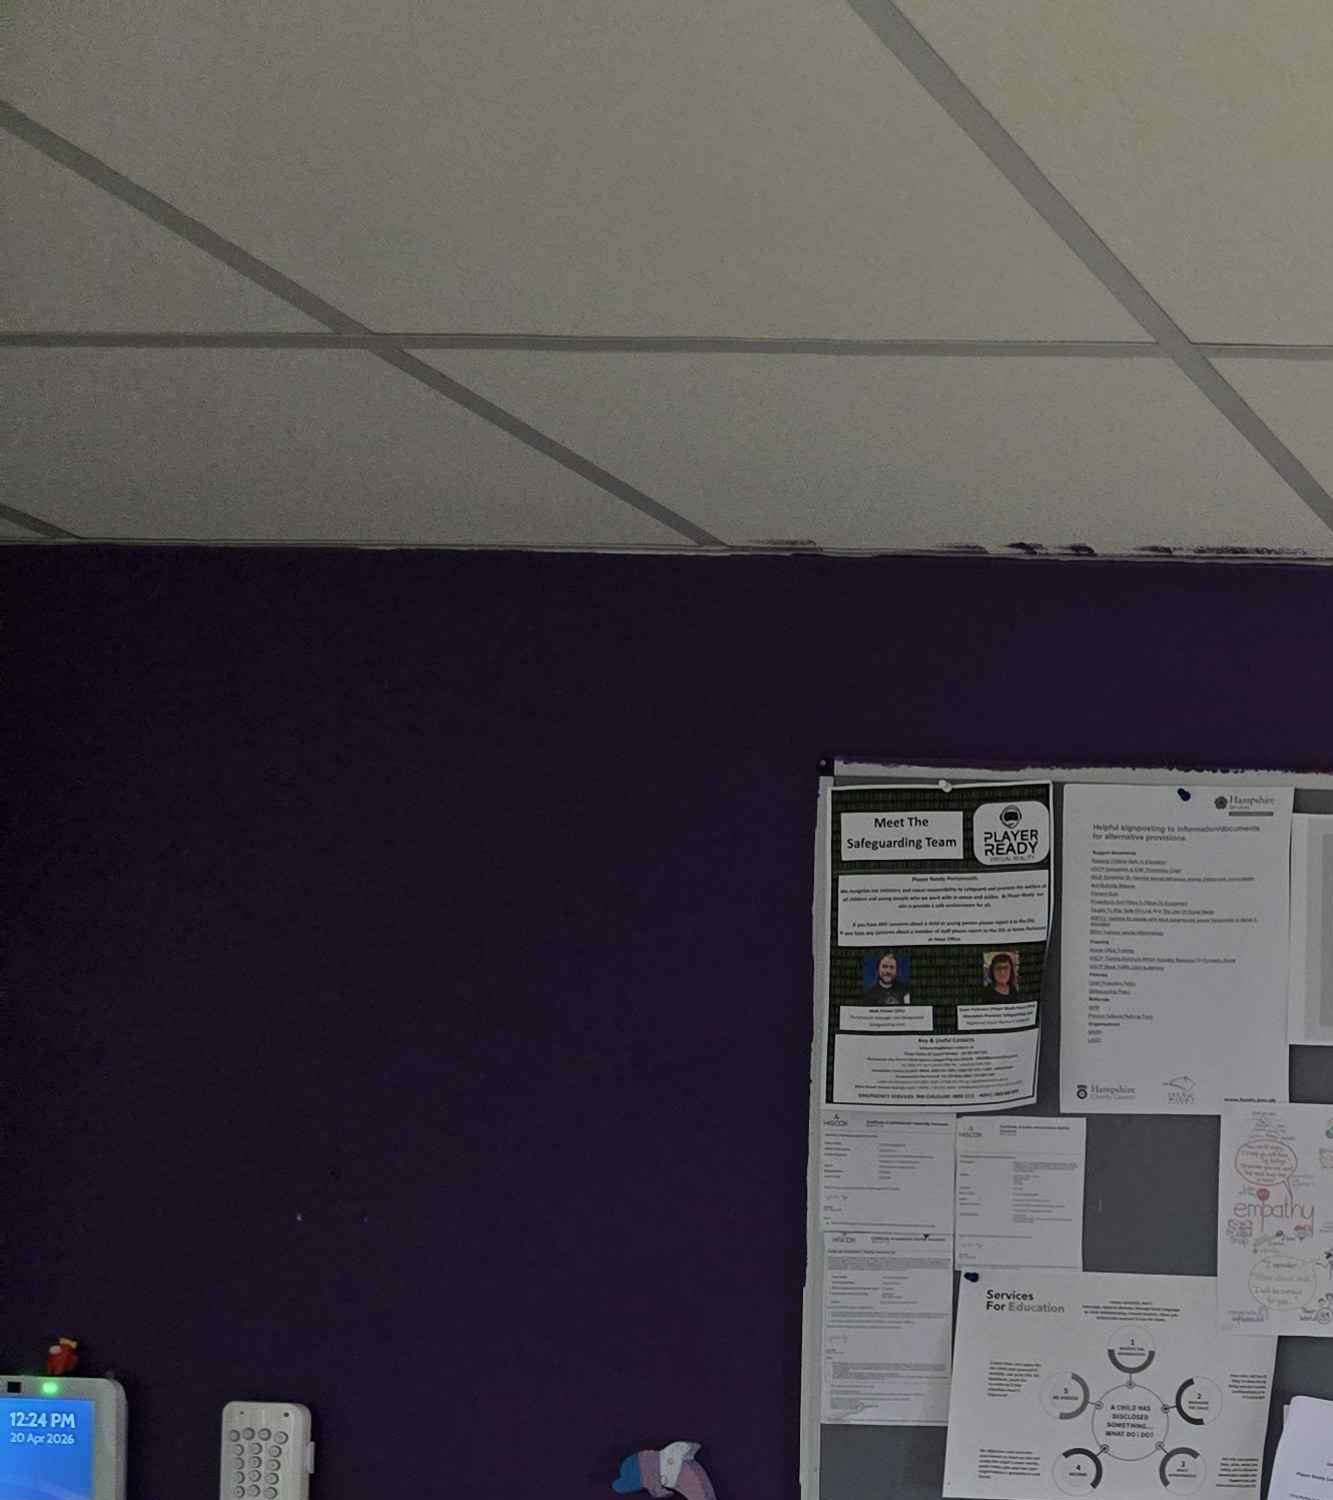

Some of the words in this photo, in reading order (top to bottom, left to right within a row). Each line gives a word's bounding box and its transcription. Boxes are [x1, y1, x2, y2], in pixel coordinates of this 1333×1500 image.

[874, 816, 905, 829] Meet
[908, 816, 929, 828] The
[983, 829, 1039, 843] PLAYER
[847, 836, 923, 851] Safeguarding
[925, 836, 957, 849] Team
[984, 843, 1038, 857] READY
[986, 1289, 1034, 1302] Services
[986, 1301, 1007, 1313] For
[1008, 1302, 1065, 1314] Education
[9, 1412, 47, 1428] 12:24
[51, 1413, 76, 1429] PM
[10, 1432, 25, 1443] 20
[26, 1432, 46, 1446] Apr
[47, 1432, 75, 1445] 2026
